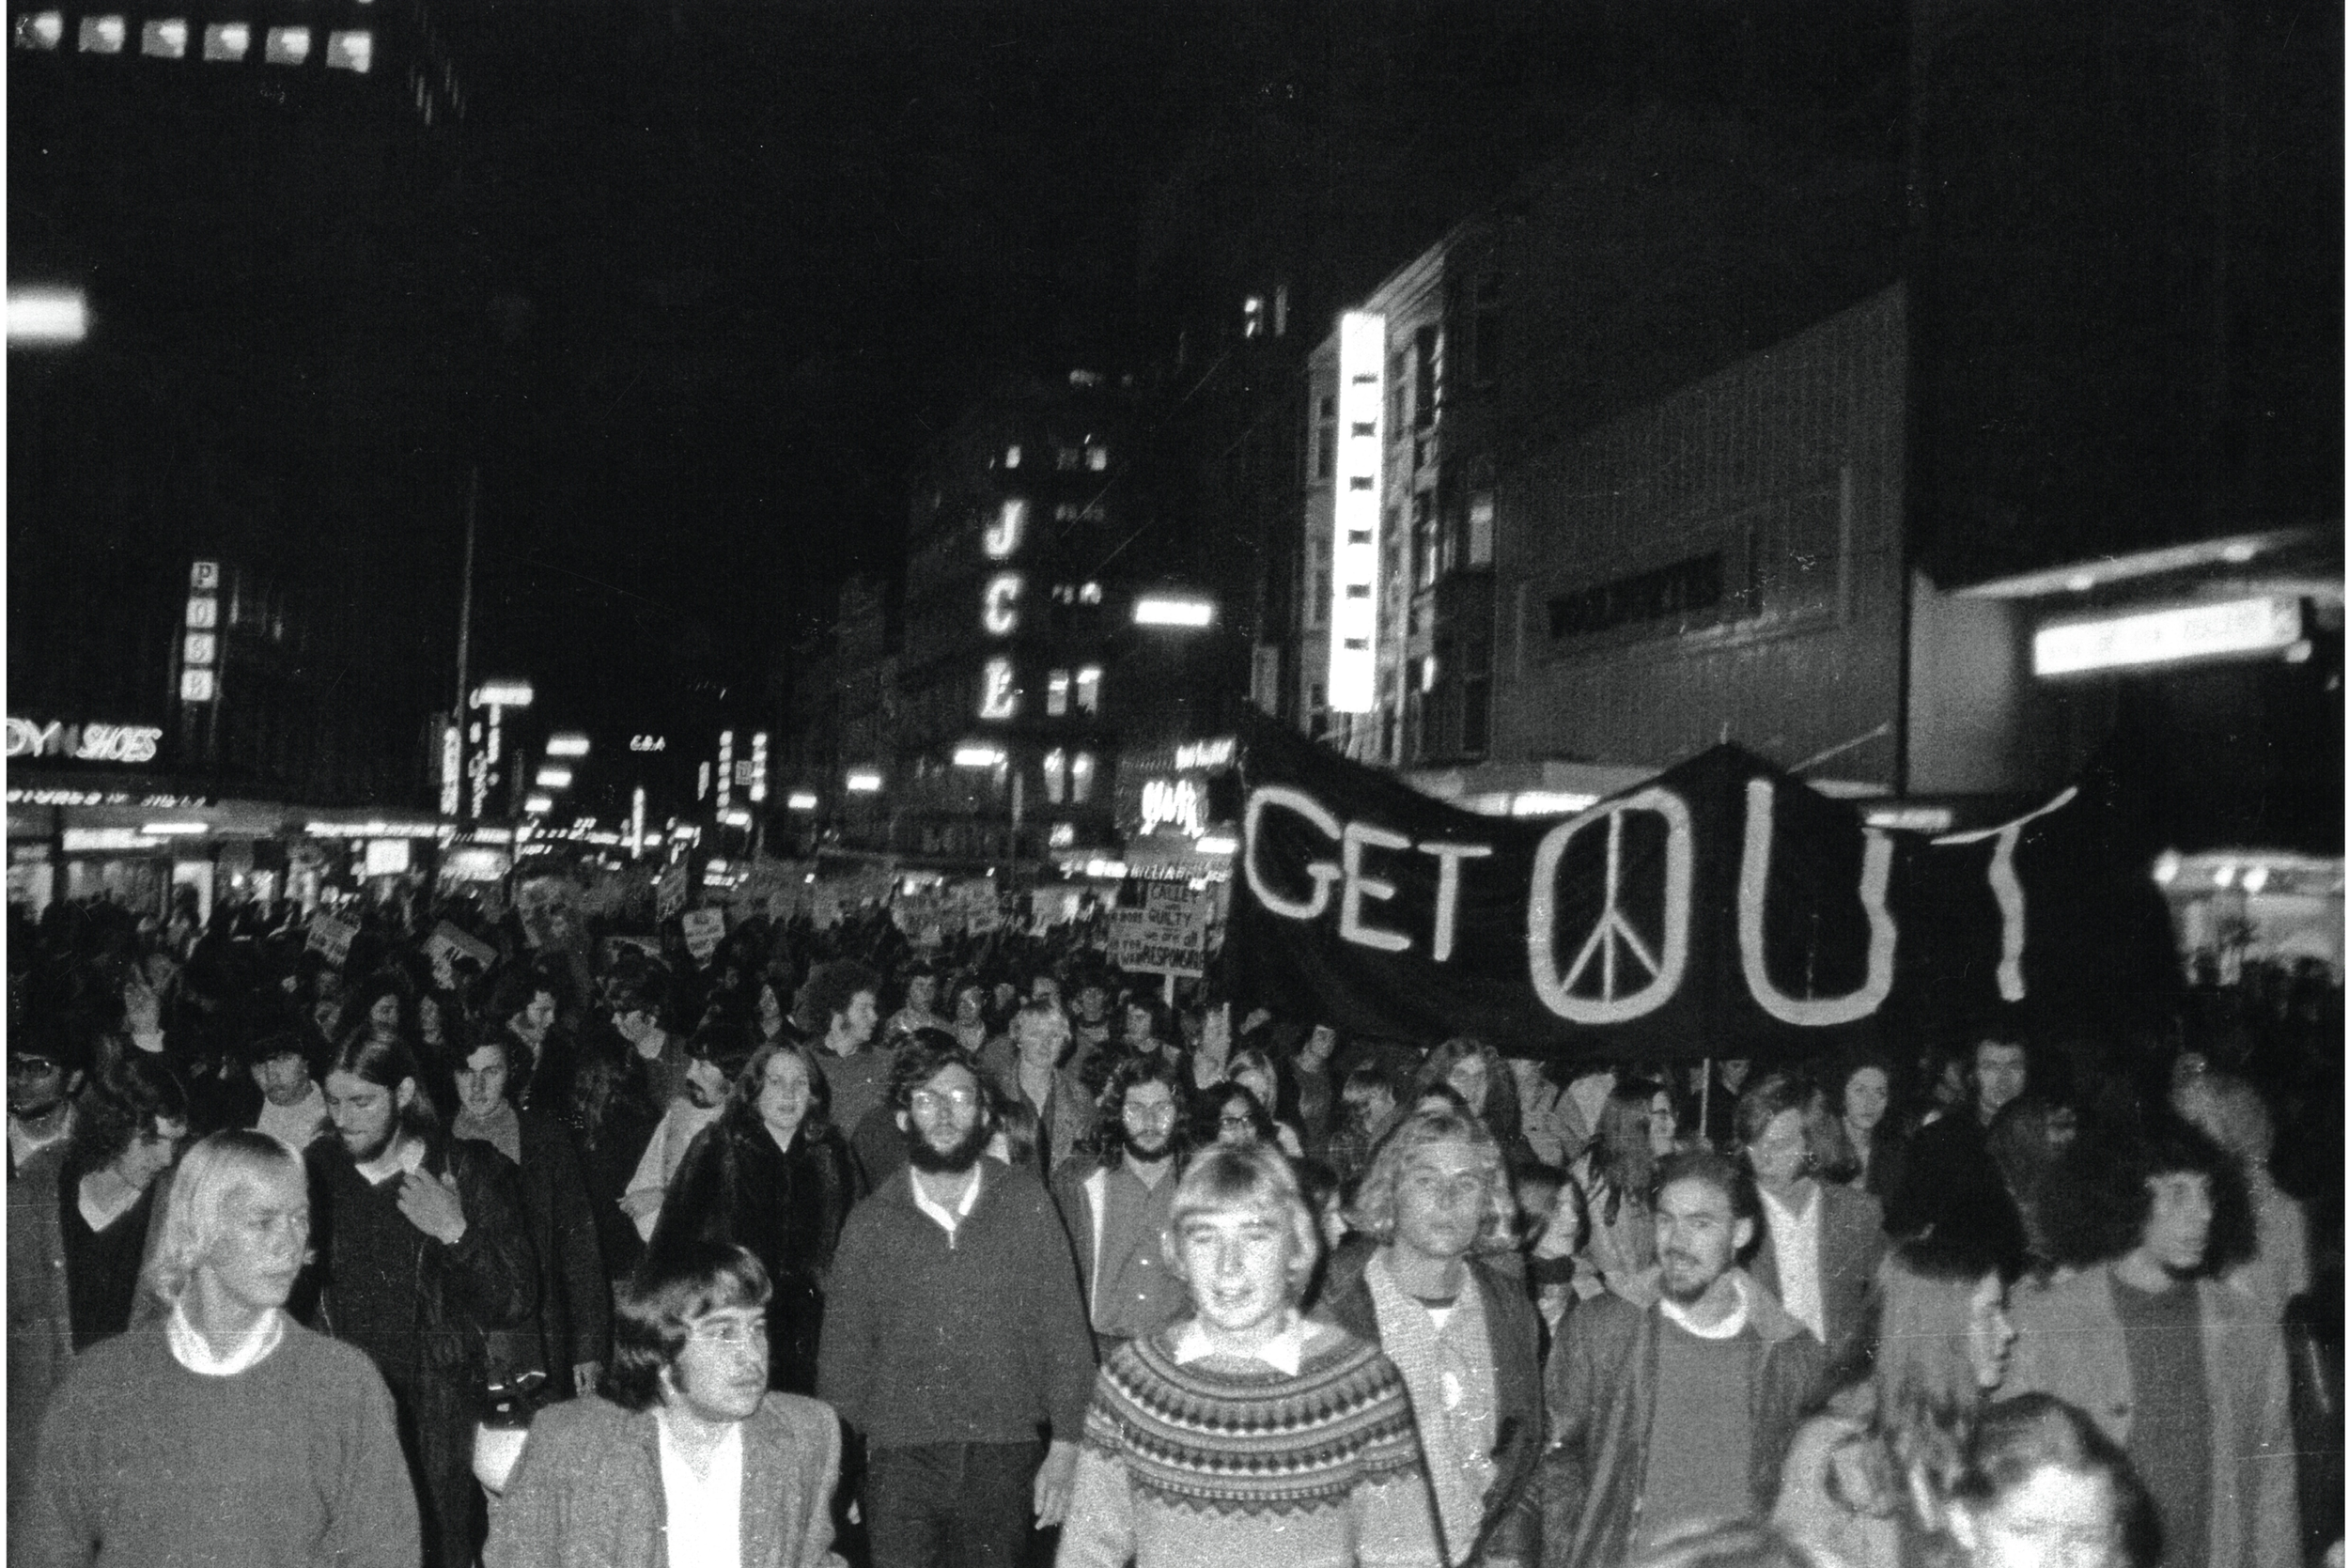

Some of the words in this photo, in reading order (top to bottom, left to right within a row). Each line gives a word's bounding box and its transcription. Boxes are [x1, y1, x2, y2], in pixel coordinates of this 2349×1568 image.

[76, 724, 163, 762] SHOES
[1244, 785, 1493, 962] GET
[1528, 778, 2079, 1026] OUT
